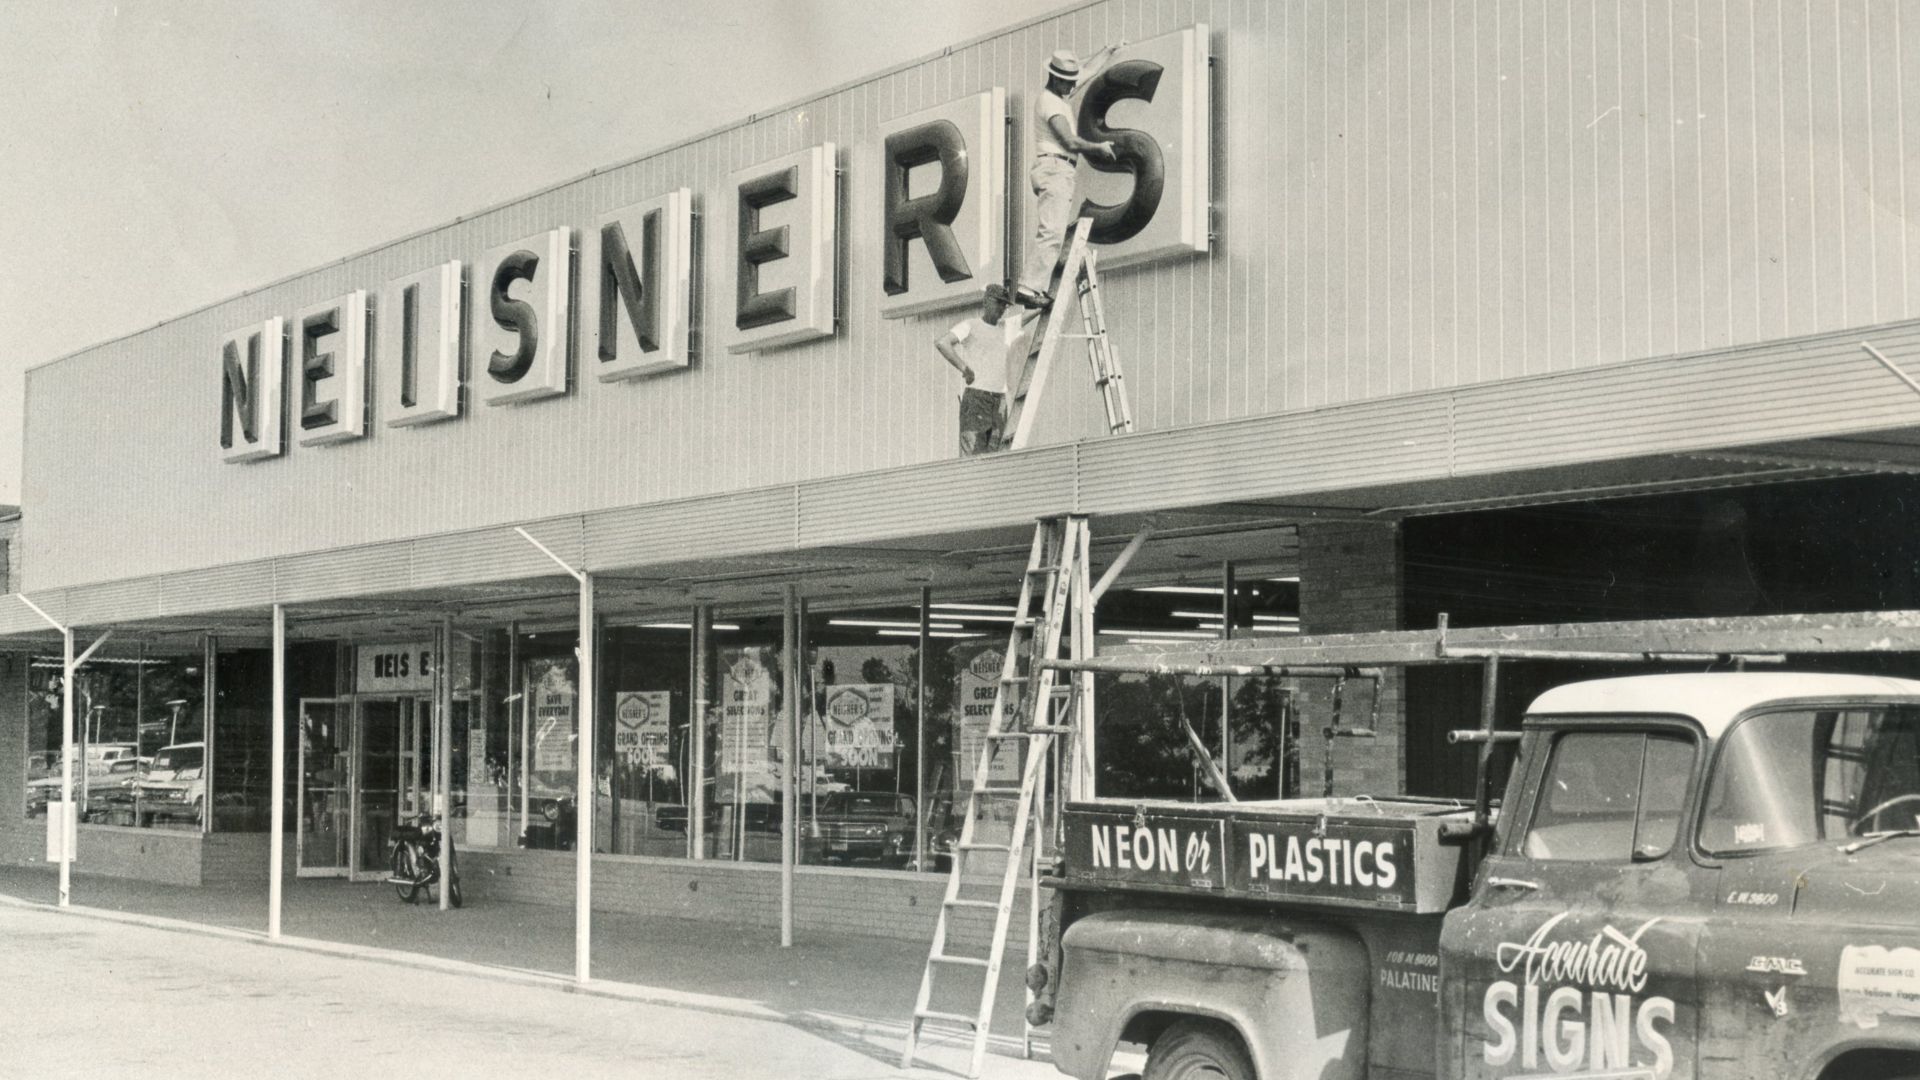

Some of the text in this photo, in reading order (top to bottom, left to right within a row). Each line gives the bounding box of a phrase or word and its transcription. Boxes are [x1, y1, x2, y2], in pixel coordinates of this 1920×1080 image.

[220, 59, 1165, 450] NEISNERS
[973, 686, 999, 700] GREA
[617, 732, 639, 746] GRAND
[840, 747, 879, 767] SOON
[1092, 824, 1211, 875] NEON or
[1249, 832, 1397, 888] PLASTICS
[1497, 911, 1662, 993] Accurate
[1747, 956, 1807, 975] GMC
[1380, 968, 1439, 993] PALATINE
[1483, 980, 1675, 1080] SIGNS
